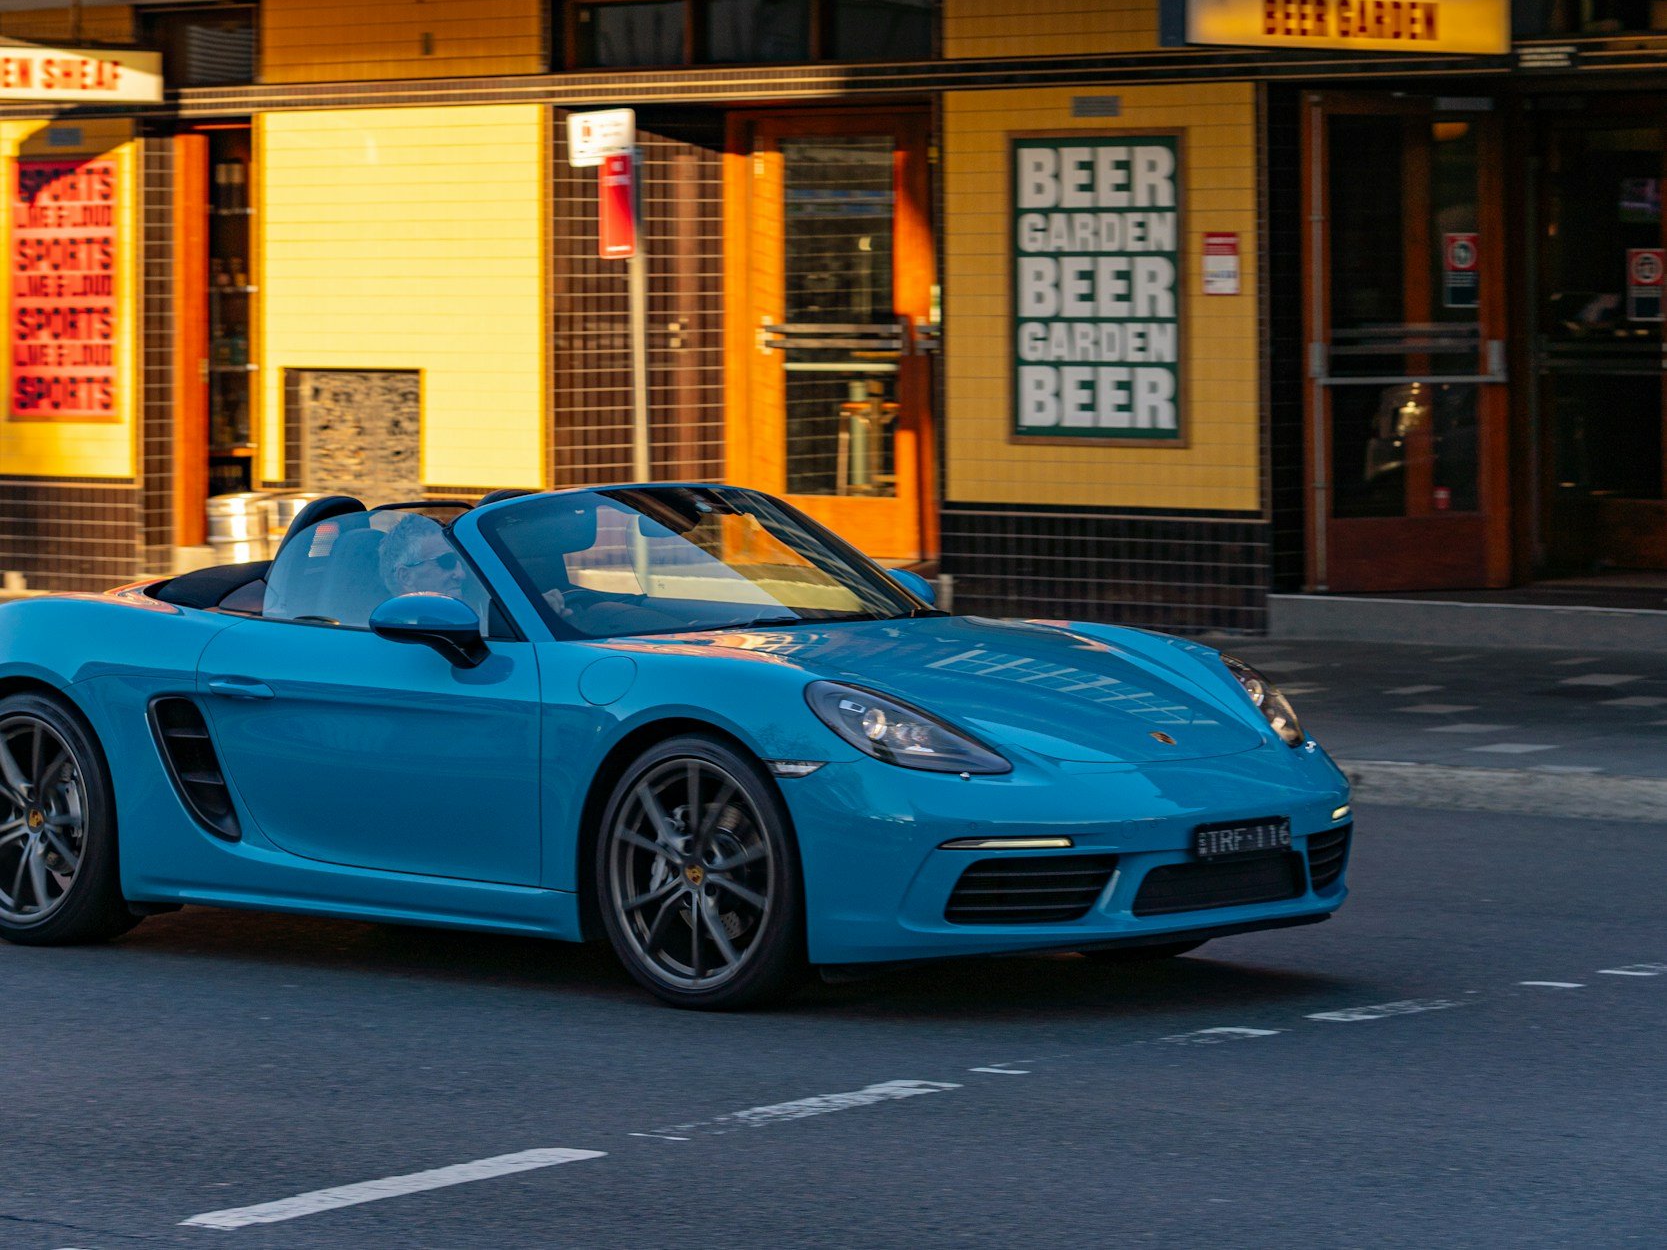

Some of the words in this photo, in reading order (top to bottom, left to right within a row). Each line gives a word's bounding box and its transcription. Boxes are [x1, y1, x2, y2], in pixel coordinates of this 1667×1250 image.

[1337, 0, 1439, 40] GARDEN
[42, 58, 121, 91] SHEAF
[1017, 145, 1175, 208] BEER
[1017, 212, 1177, 252] GARDEN
[15, 237, 112, 272] SPORTS
[1017, 256, 1176, 317] BEER
[15, 306, 112, 341] SPORTS
[1017, 322, 1177, 362] GARDEN
[1017, 366, 1177, 429] BEER
